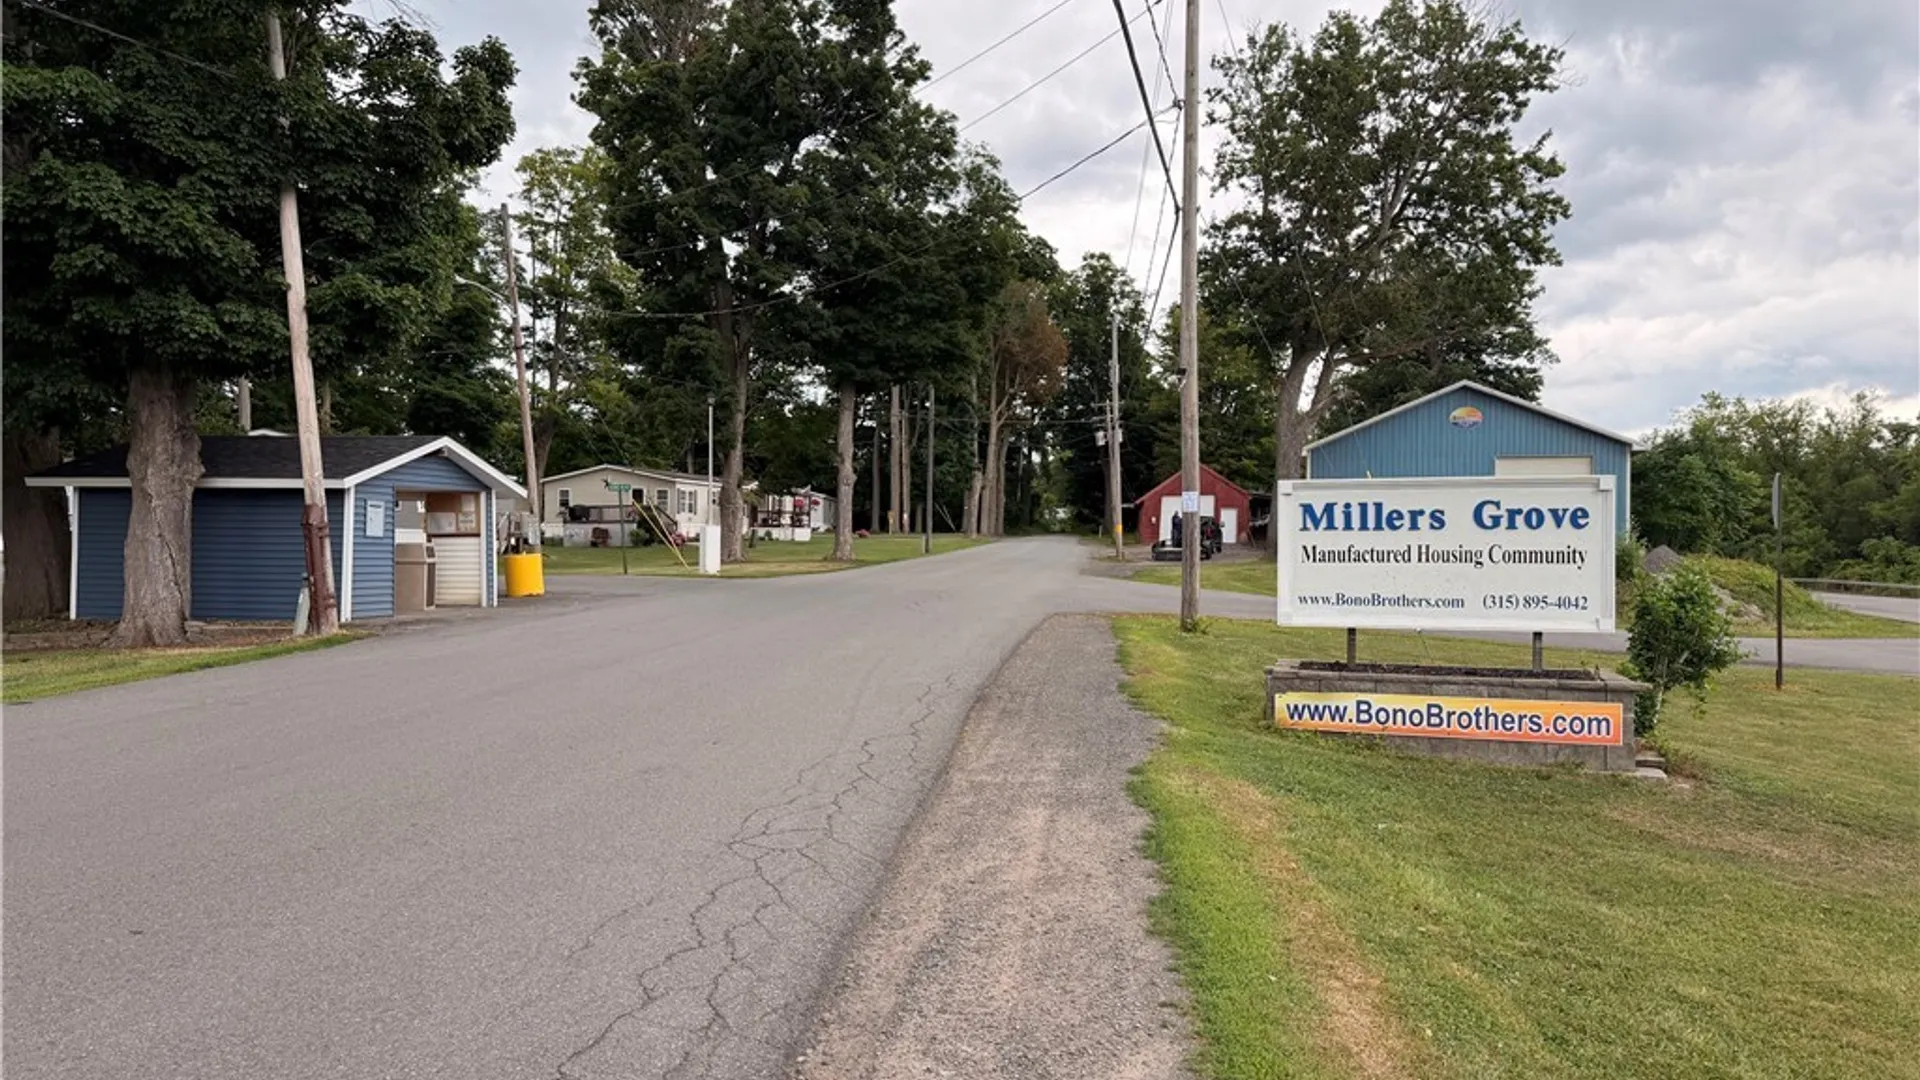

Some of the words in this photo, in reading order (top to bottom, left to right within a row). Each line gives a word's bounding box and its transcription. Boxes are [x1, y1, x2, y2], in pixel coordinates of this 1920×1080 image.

[1299, 502, 1446, 531] Millers
[1473, 500, 1590, 531] Grove
[1301, 544, 1412, 565] Manufactured
[1416, 544, 1484, 568] Housing
[1488, 544, 1588, 570] Community
[1297, 592, 1465, 609] www.BonoBrothers.com
[1482, 595, 1519, 611] (315)
[1522, 595, 1589, 611] 895-4042
[1286, 700, 1612, 736] www.BonoBrothers.com
